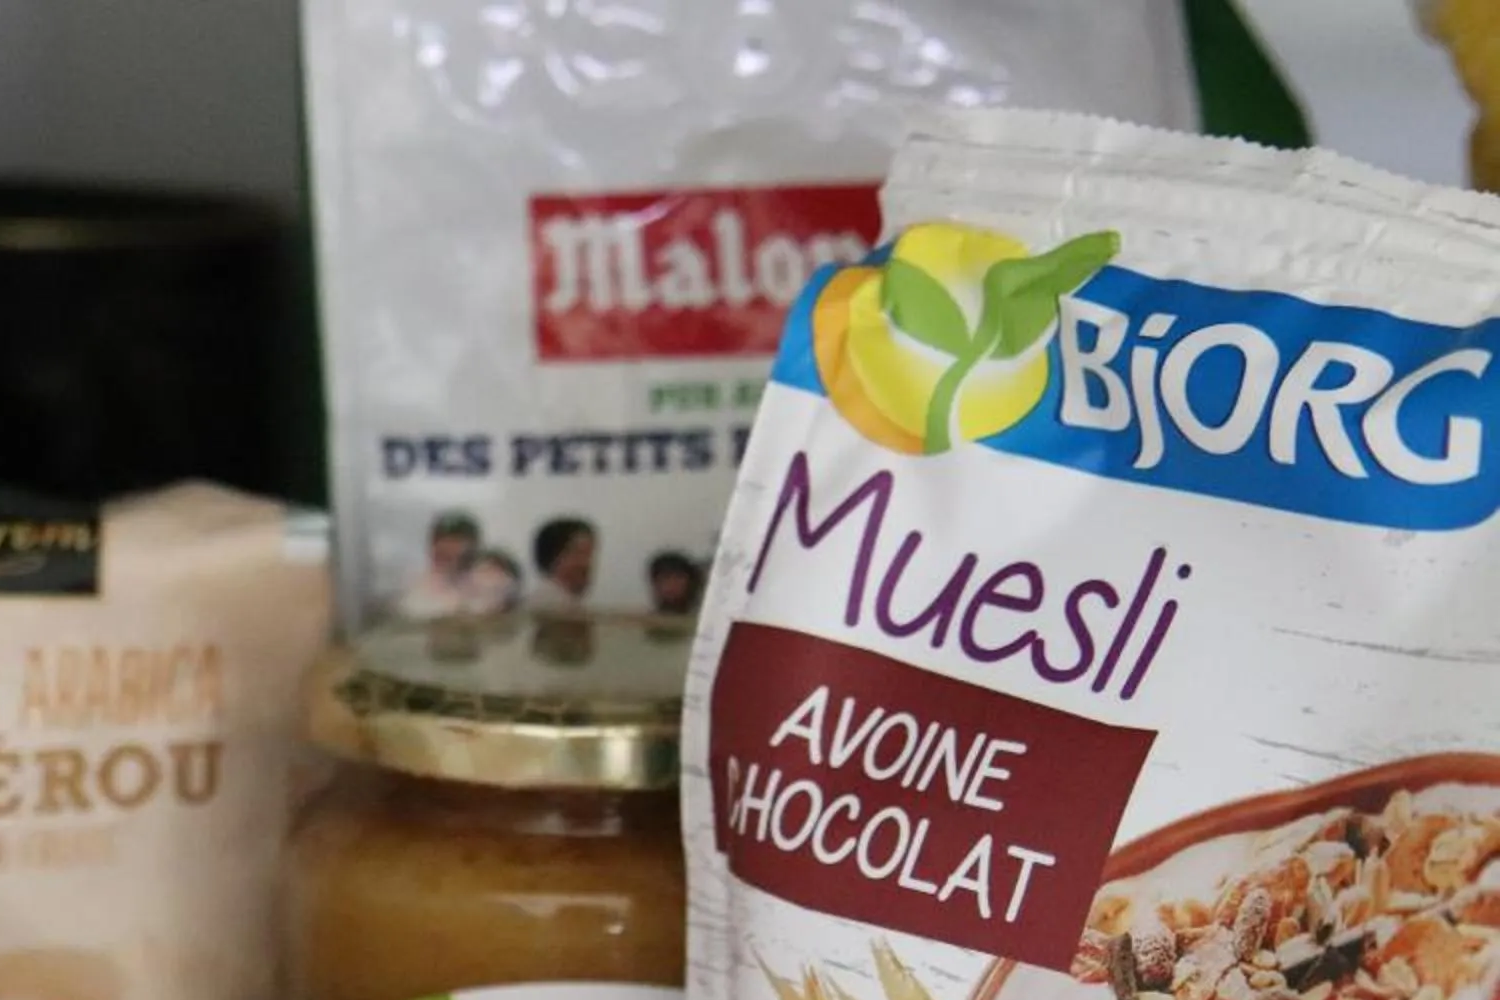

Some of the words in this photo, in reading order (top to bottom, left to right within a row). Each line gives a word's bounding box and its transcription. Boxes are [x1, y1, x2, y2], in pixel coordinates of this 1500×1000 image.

[381, 433, 491, 478] DES
[511, 427, 714, 475] PETITS
[747, 451, 1194, 700] Muesli
[769, 685, 1027, 812] AVOINE
